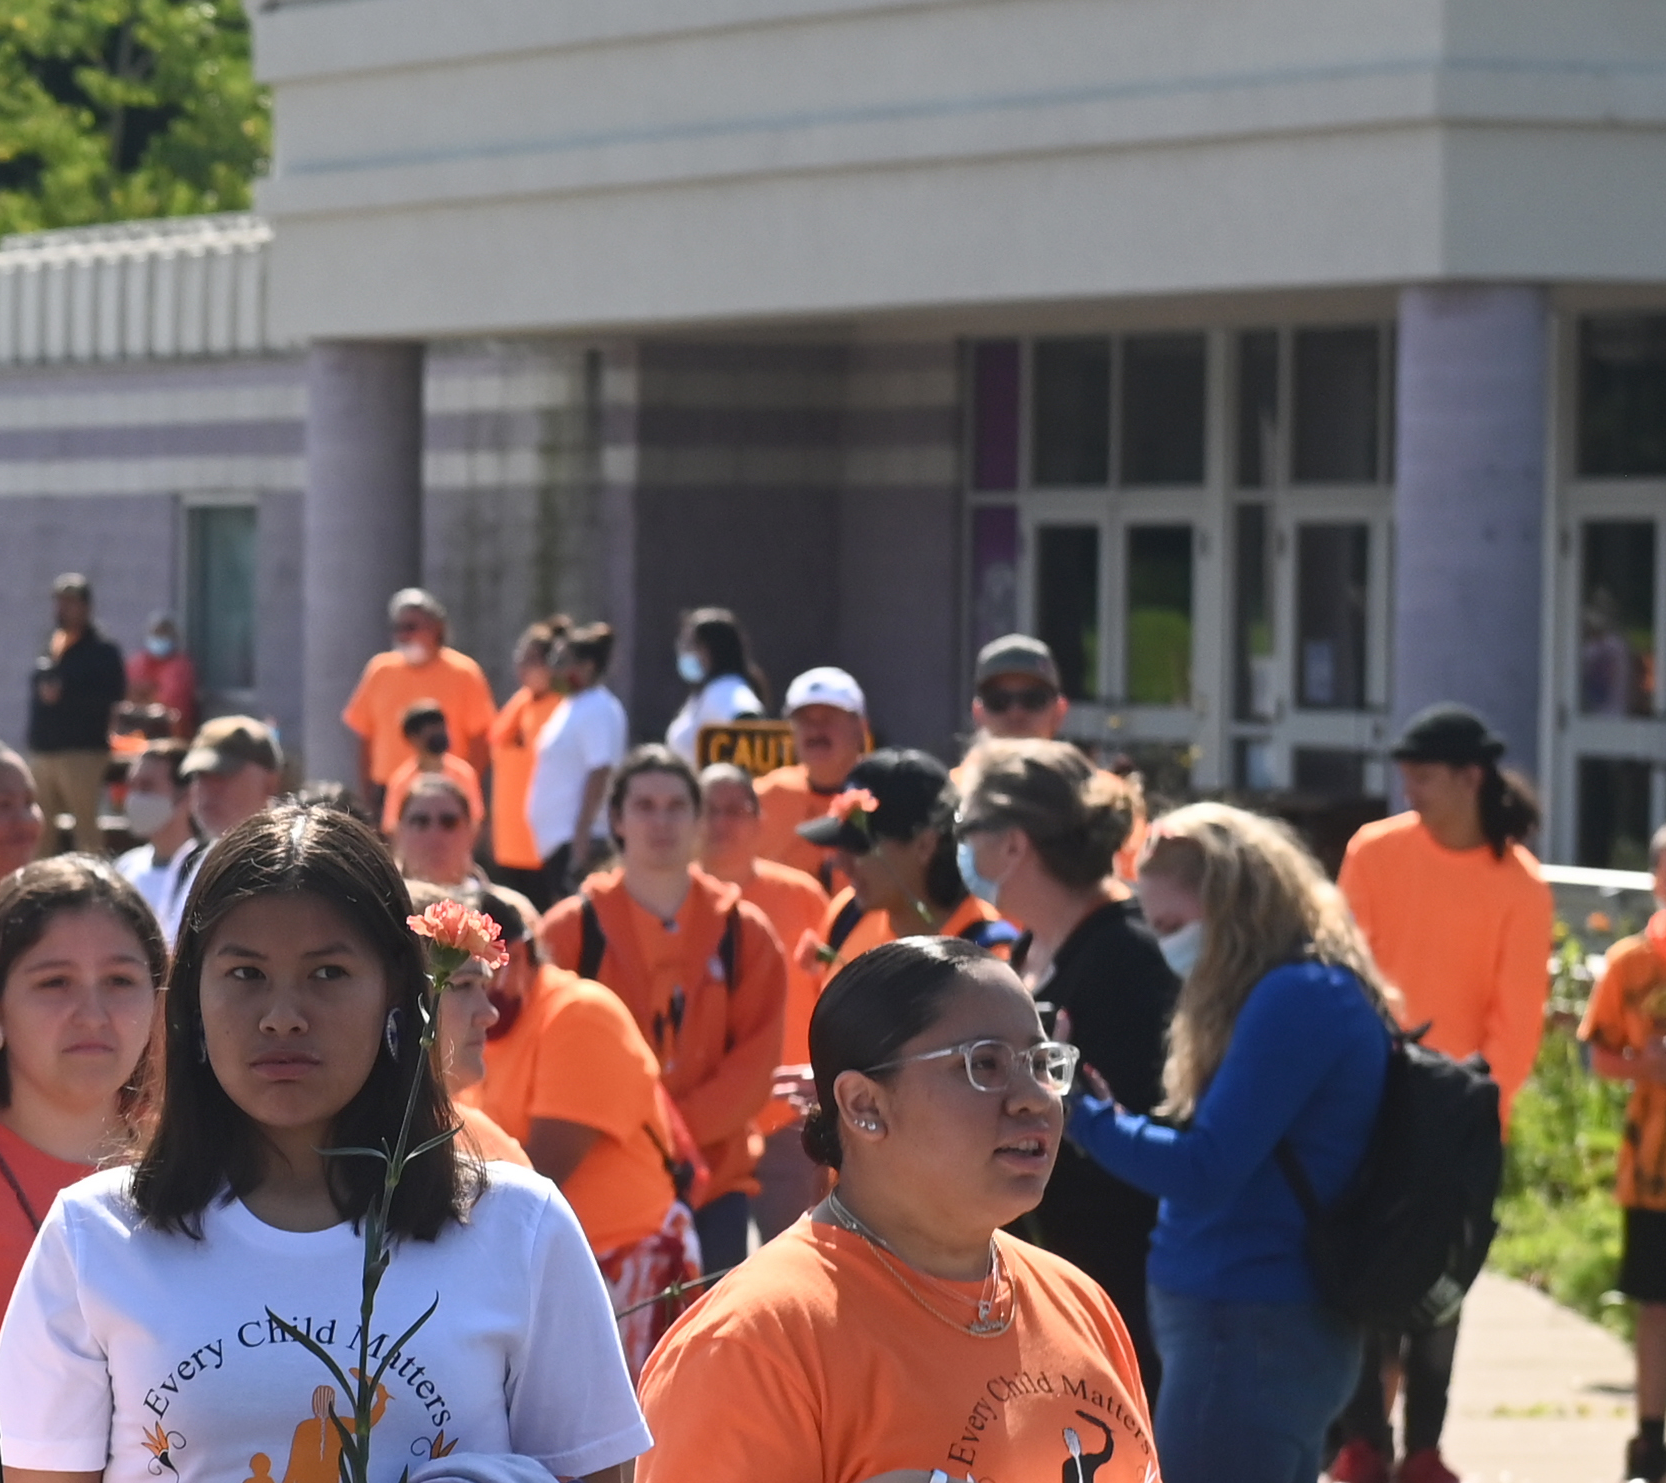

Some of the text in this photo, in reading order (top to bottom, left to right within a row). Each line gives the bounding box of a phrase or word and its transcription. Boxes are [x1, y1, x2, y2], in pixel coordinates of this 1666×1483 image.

[143, 1337, 226, 1420] Every
[237, 1316, 337, 1348] Child
[947, 1371, 1152, 1468] Every Child Matters
